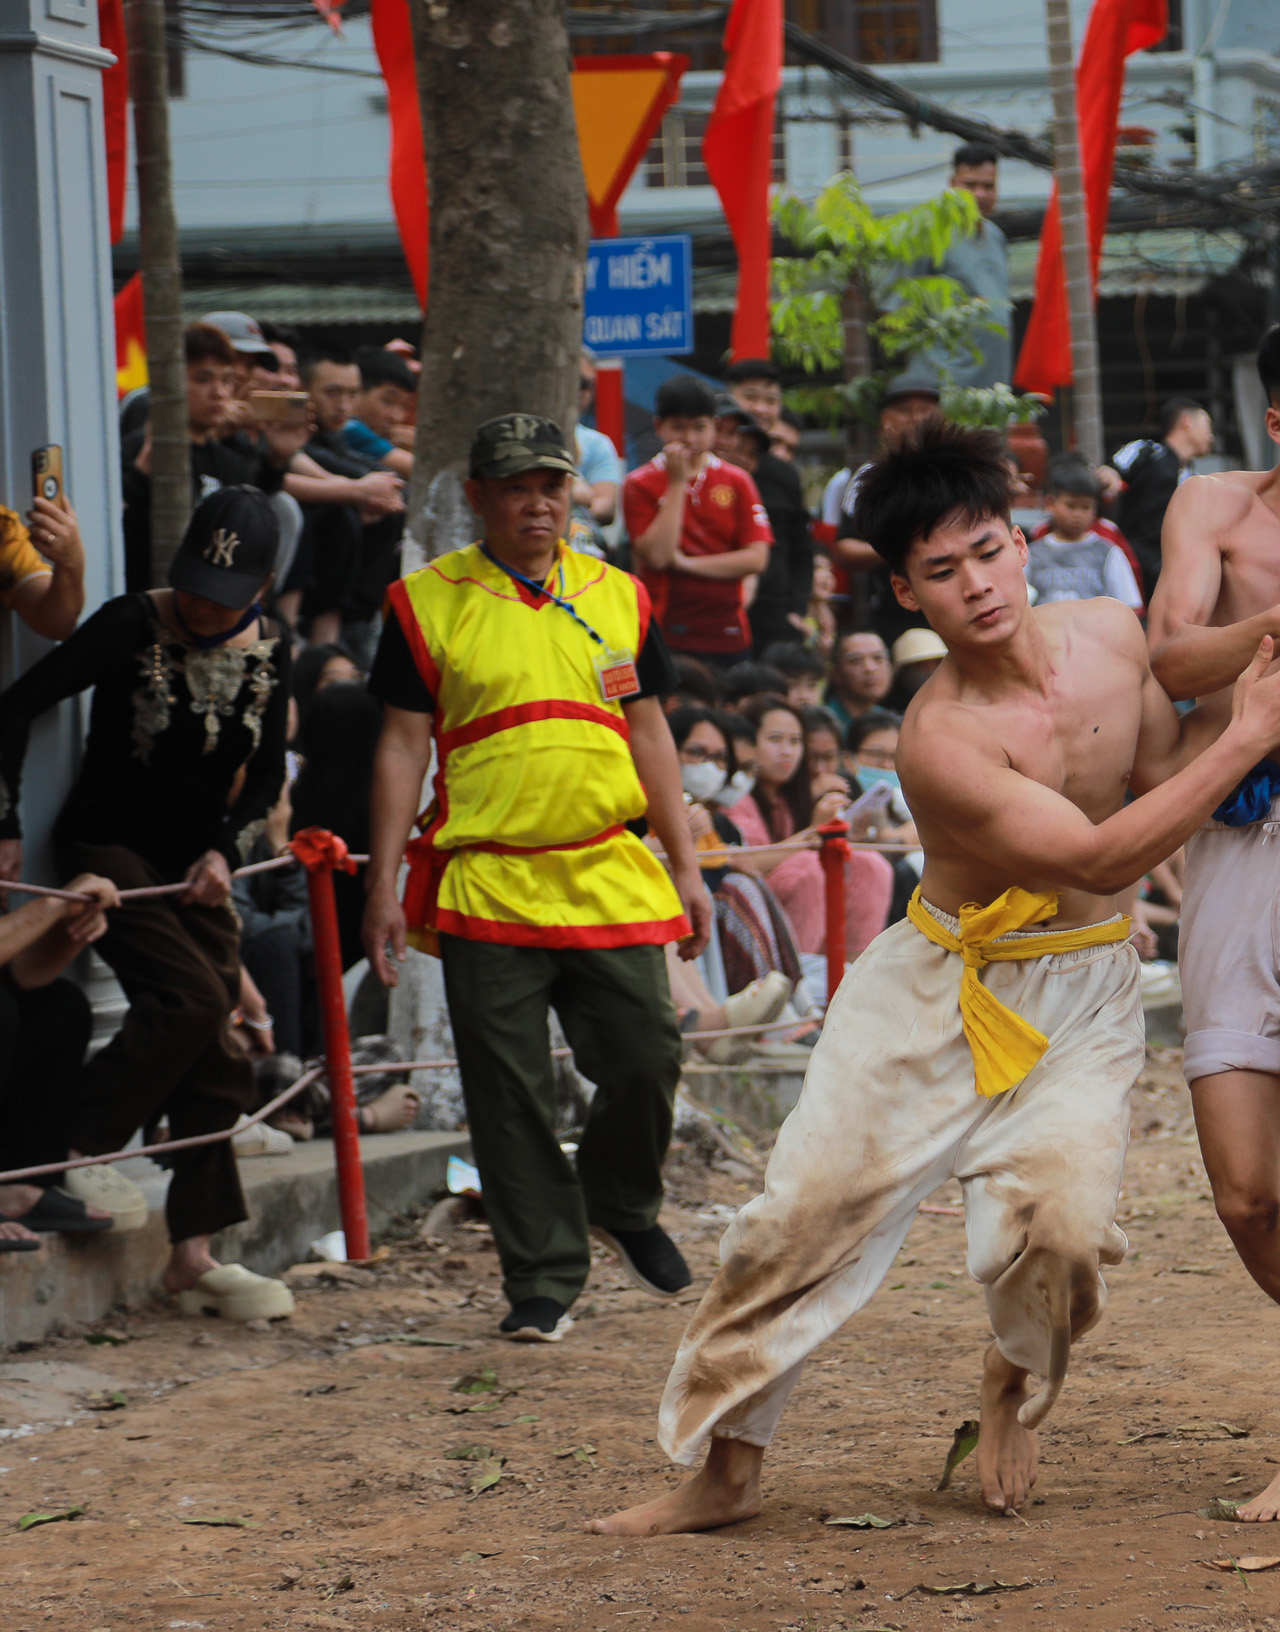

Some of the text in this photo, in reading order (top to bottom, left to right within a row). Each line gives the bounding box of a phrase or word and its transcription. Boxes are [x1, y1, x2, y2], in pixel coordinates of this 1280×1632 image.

[608, 241, 672, 290] HIỂM
[584, 304, 684, 344] QUAN SÁT
